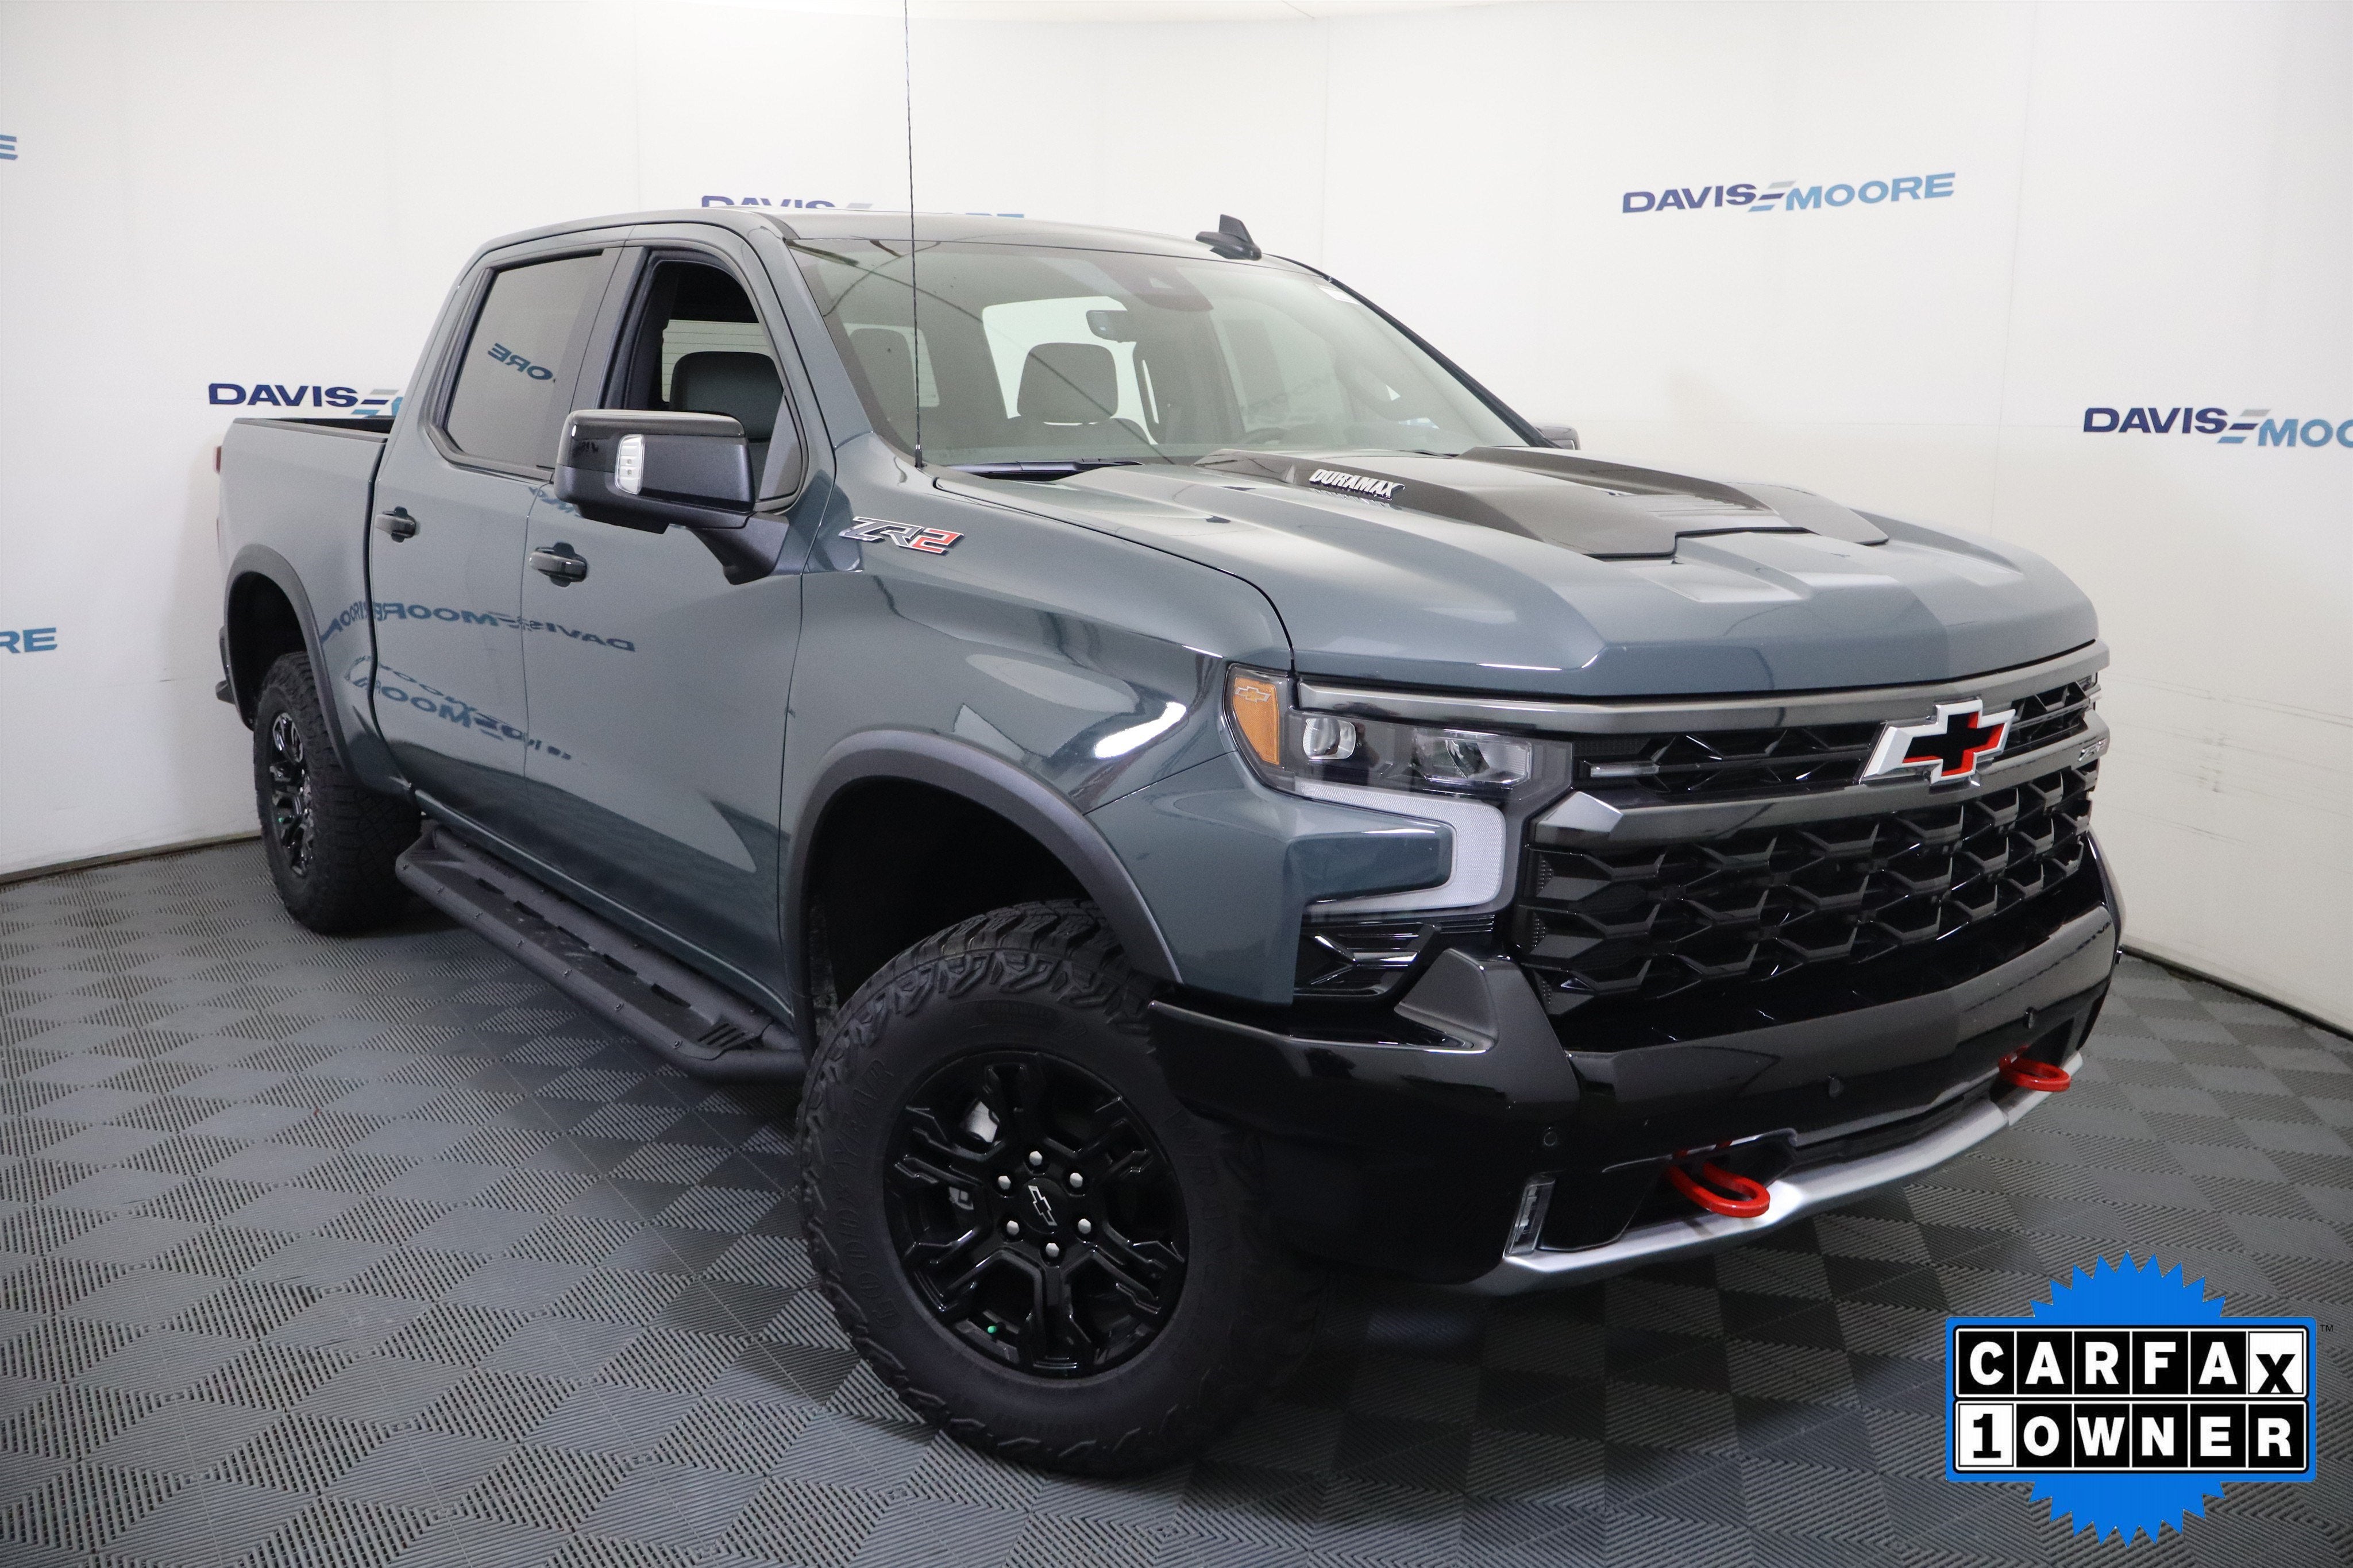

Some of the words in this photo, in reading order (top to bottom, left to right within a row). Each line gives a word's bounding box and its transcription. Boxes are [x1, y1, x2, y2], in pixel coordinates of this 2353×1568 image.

[1622, 183, 1757, 213] DAVIS
[1785, 172, 1956, 211] MOORE
[209, 383, 358, 407] DAVIS
[2083, 407, 2228, 434] DAVIS
[1309, 469, 1406, 499] DURAMAX
[838, 516, 965, 555] ZR2
